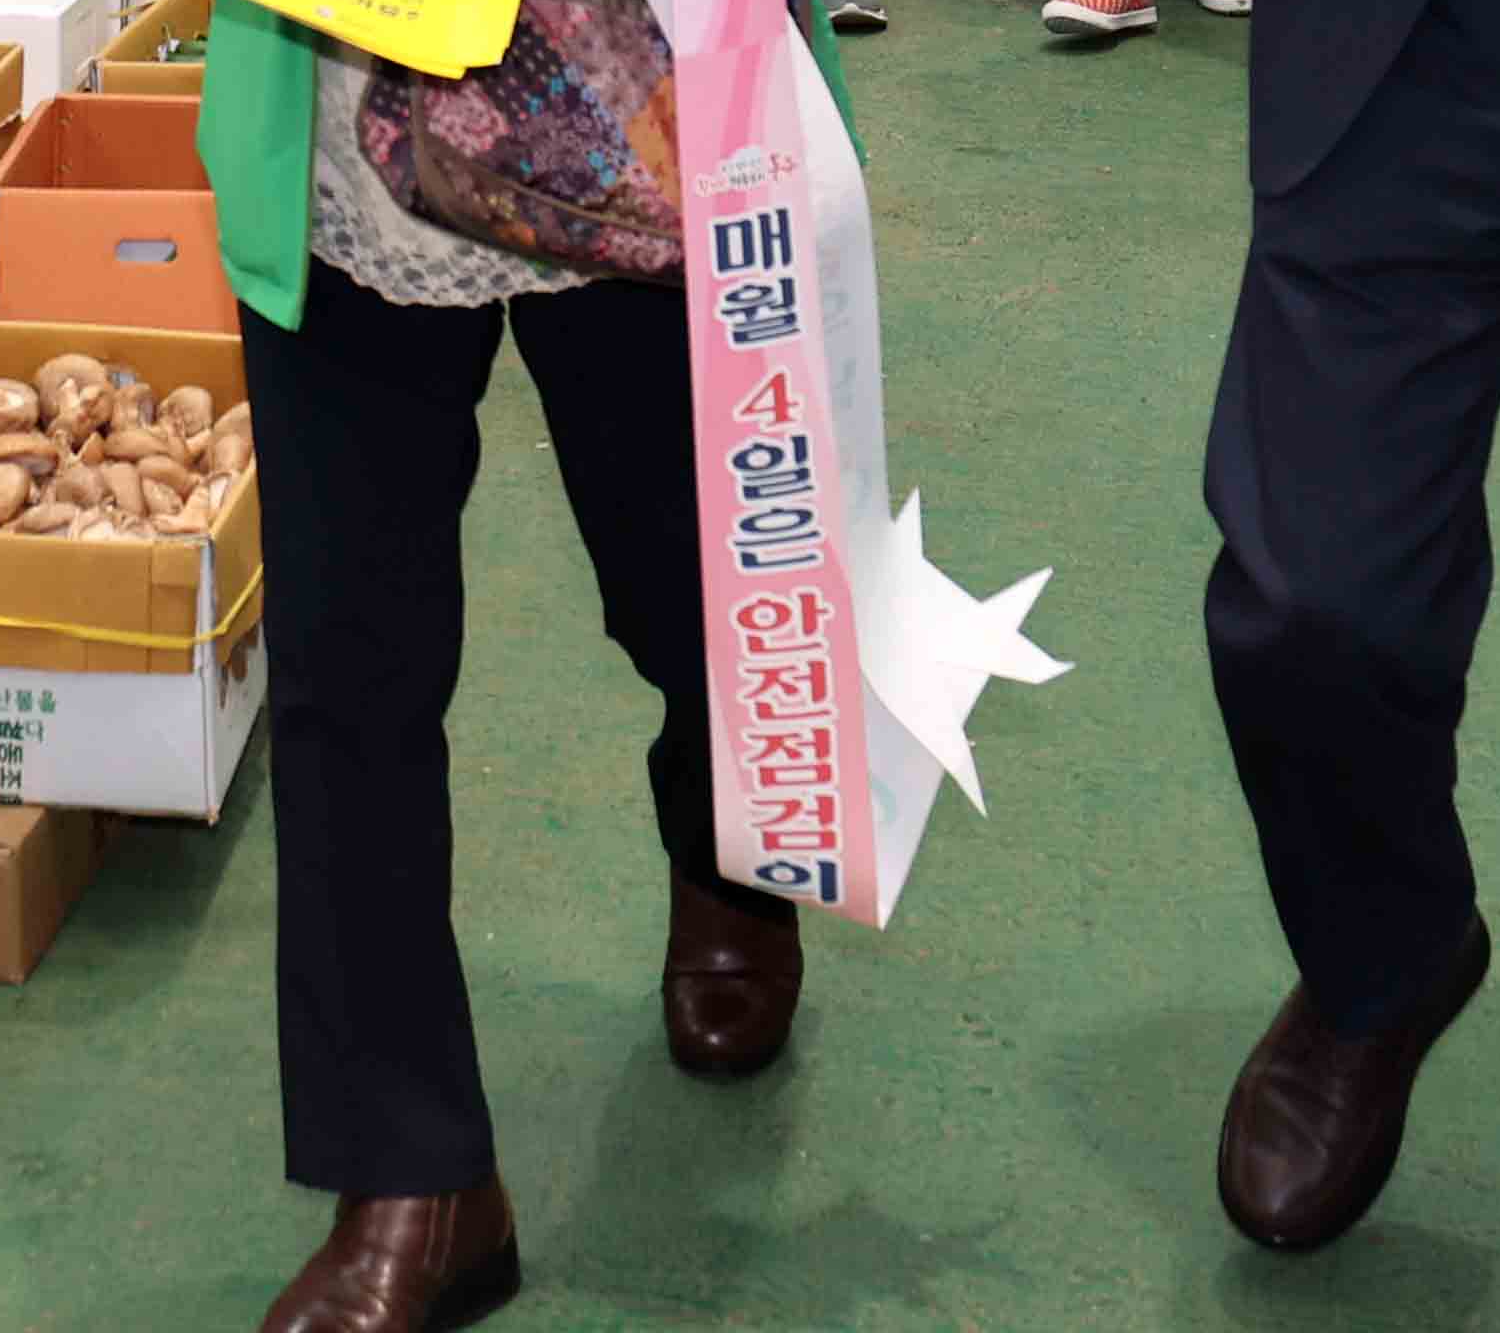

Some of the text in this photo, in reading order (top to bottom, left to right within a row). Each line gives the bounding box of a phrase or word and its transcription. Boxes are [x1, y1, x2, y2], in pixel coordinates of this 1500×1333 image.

[711, 207, 802, 347] 매월
[726, 368, 825, 574] 4일은
[734, 591, 843, 906] 안전점검의
